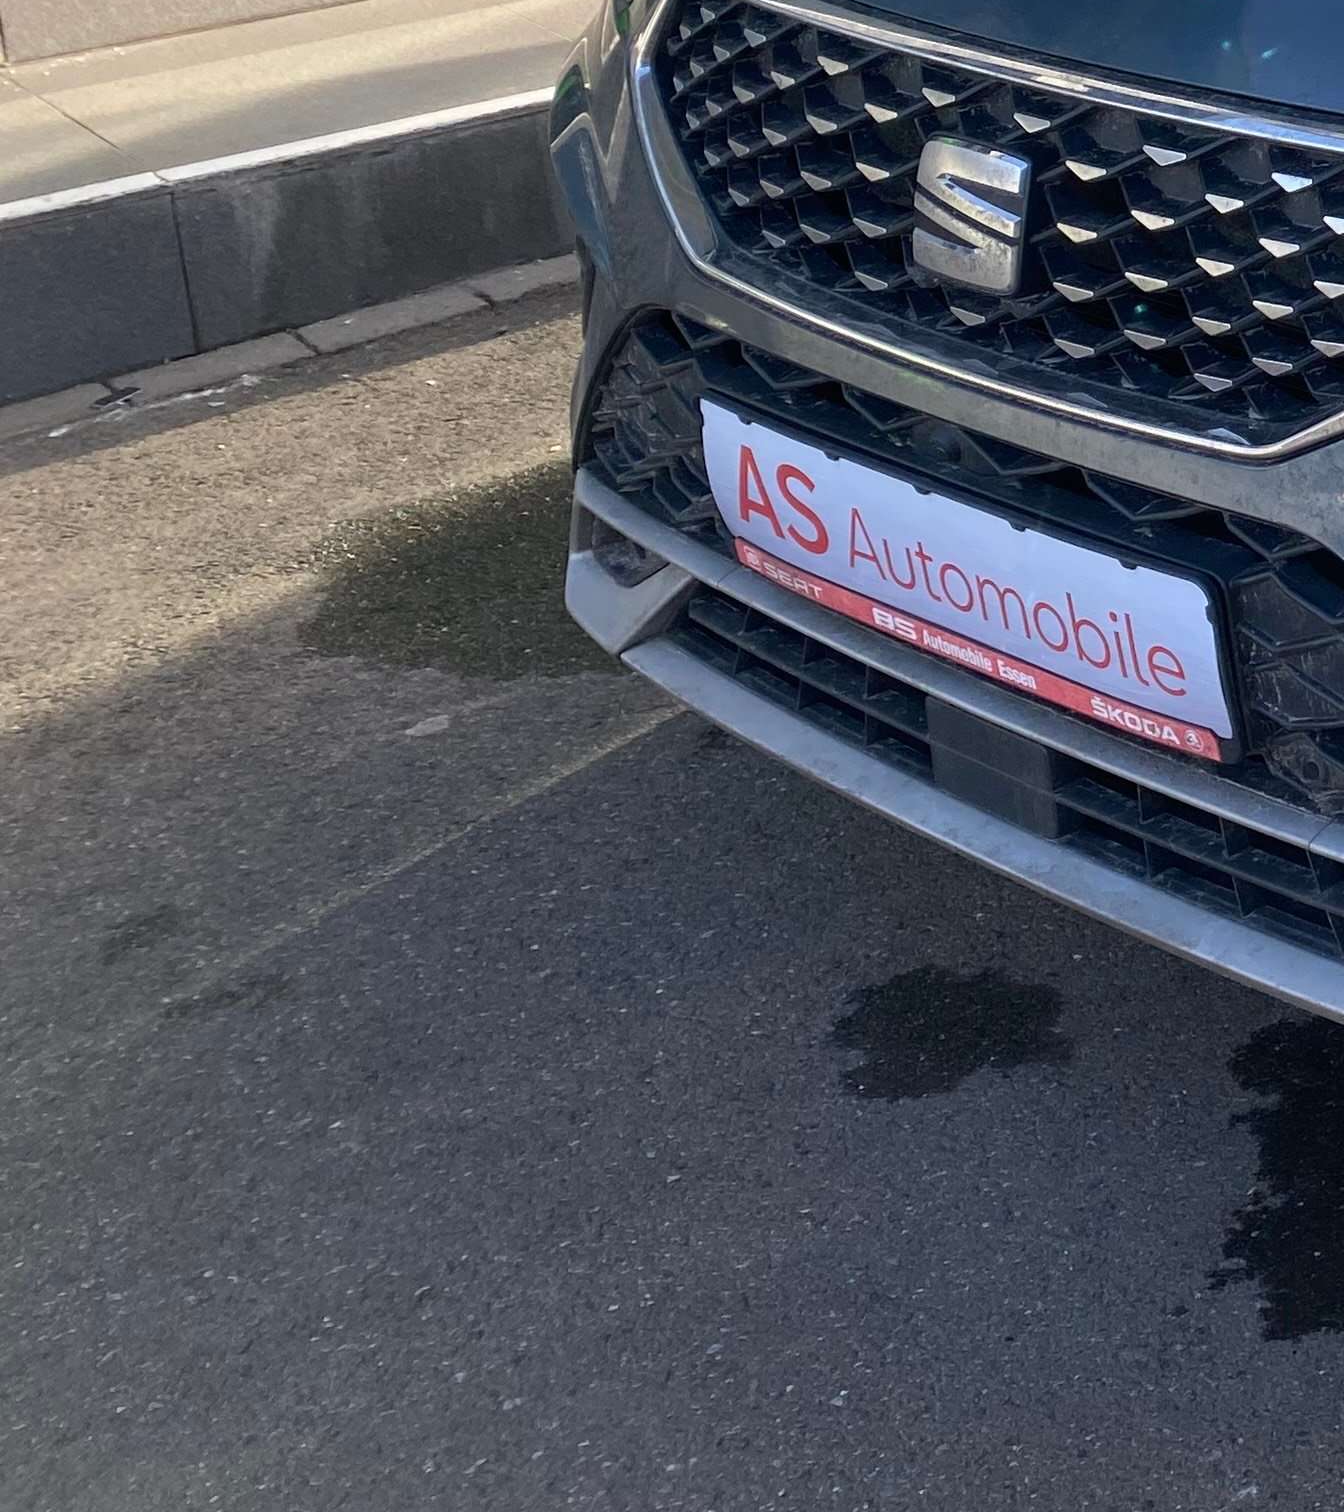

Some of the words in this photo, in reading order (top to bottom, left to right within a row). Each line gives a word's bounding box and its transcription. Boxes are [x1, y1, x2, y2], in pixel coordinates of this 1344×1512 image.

[738, 444, 830, 555] AS
[849, 507, 1187, 697] Automobile
[763, 562, 823, 600] SEAT
[922, 629, 993, 673] Automobile
[996, 659, 1037, 690] Essen
[1090, 695, 1181, 745] ŠKODA
